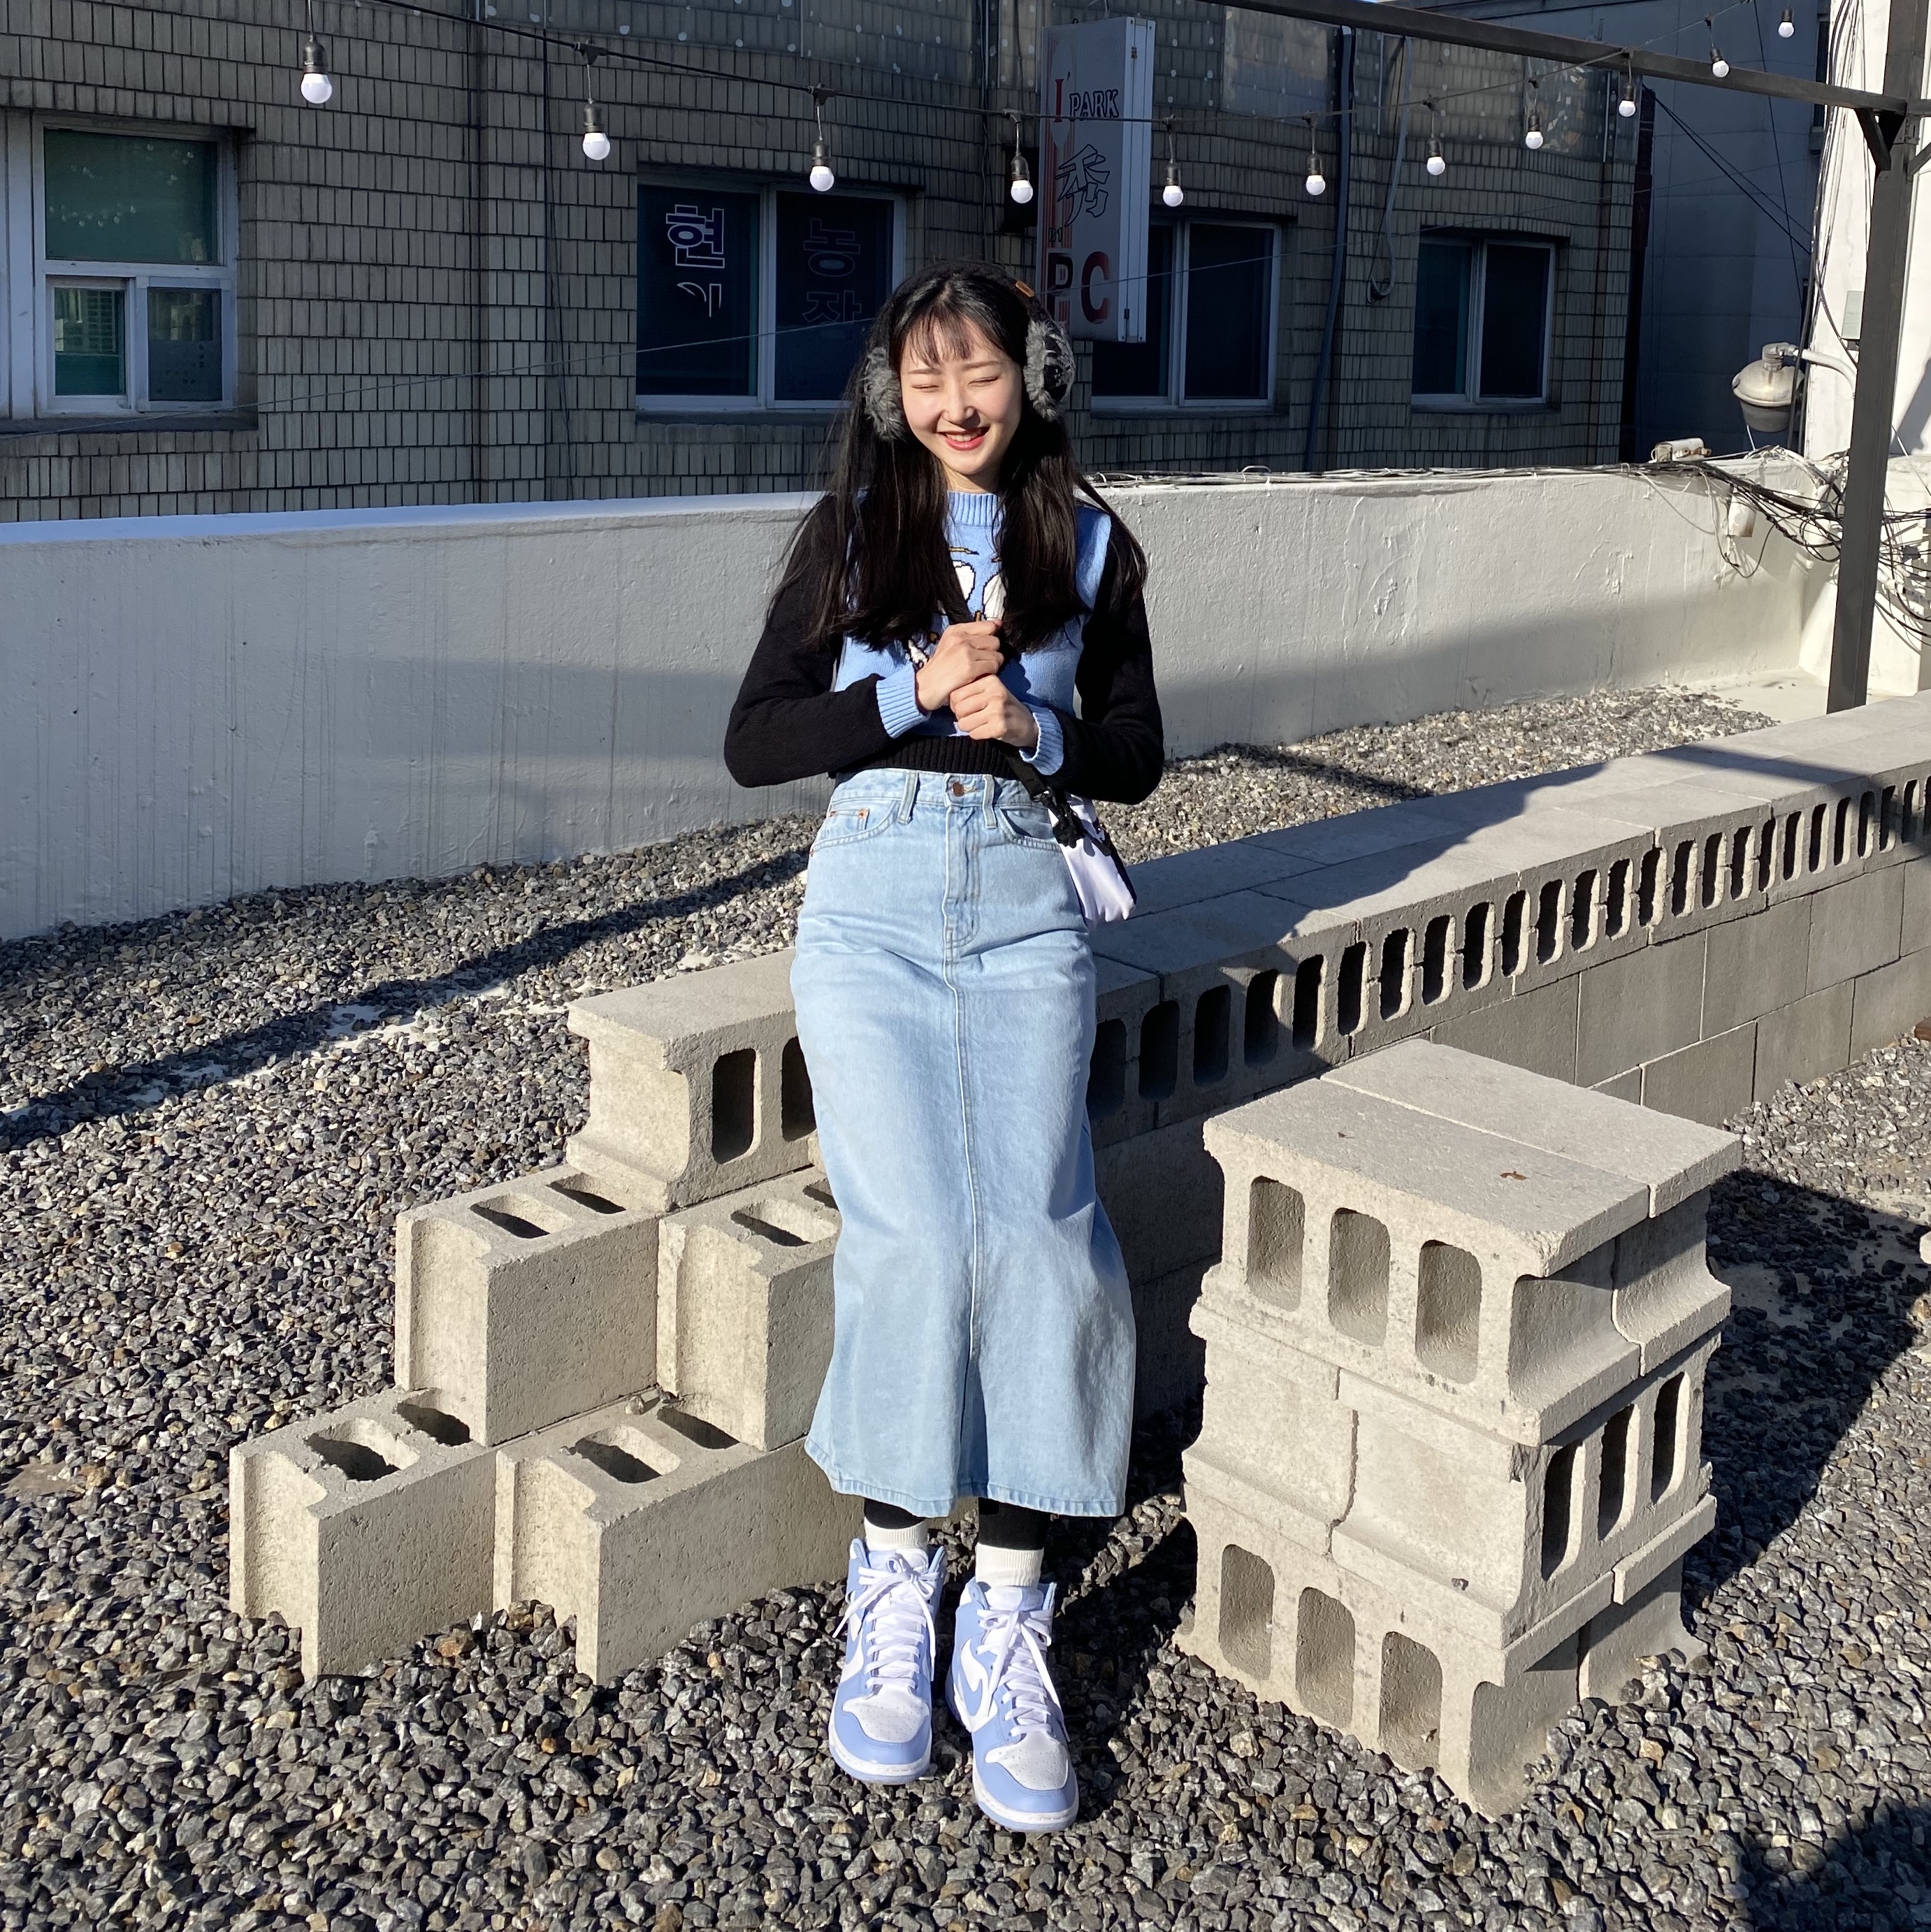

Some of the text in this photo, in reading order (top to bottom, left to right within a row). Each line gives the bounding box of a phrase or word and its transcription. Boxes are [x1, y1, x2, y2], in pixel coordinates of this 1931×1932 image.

[1055, 143, 1110, 227] 秀
[1048, 227, 1063, 243] B1
[1047, 251, 1108, 324] PC
